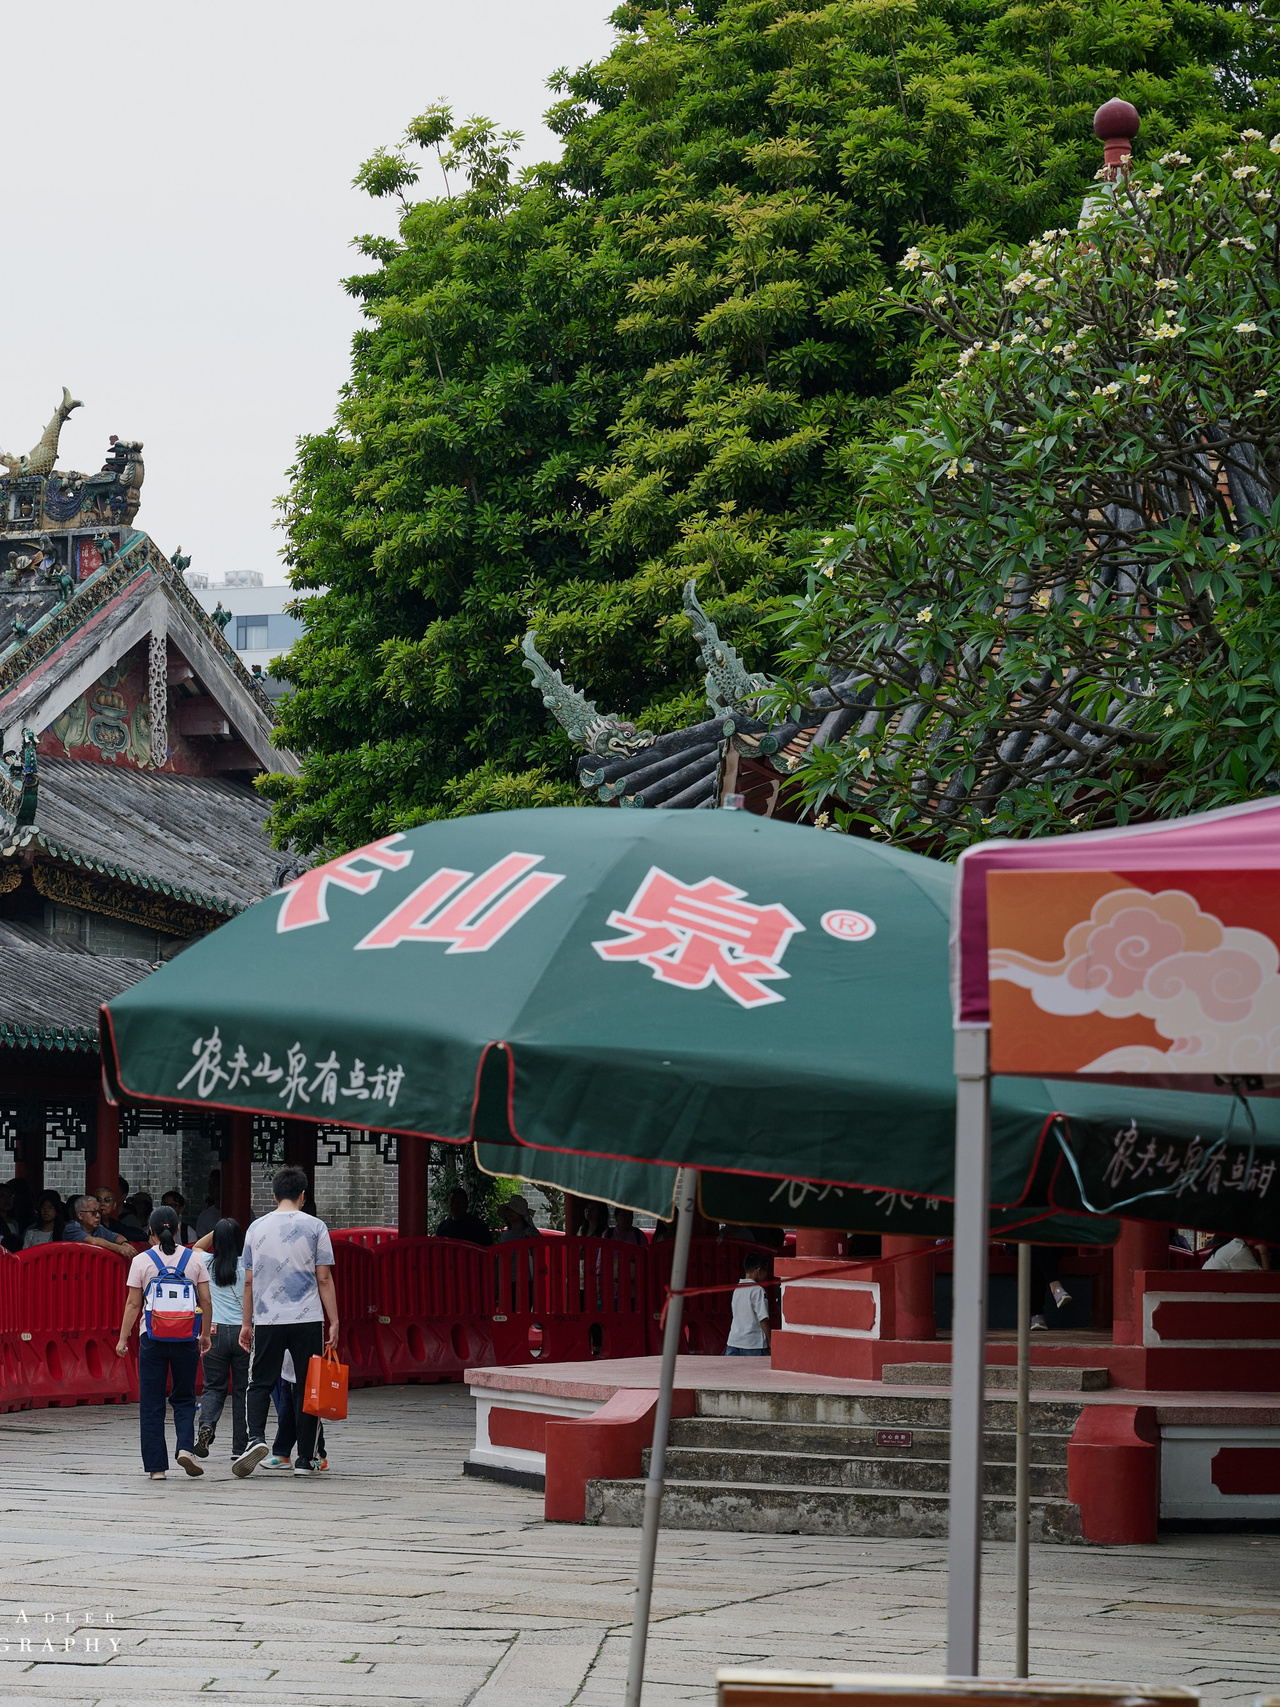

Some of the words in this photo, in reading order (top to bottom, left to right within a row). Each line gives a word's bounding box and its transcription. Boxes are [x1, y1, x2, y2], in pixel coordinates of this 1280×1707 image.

[177, 1025, 405, 1110] 农夫山泉有点甜
[1102, 1117, 1276, 1199] 农夫山泉有点甜
